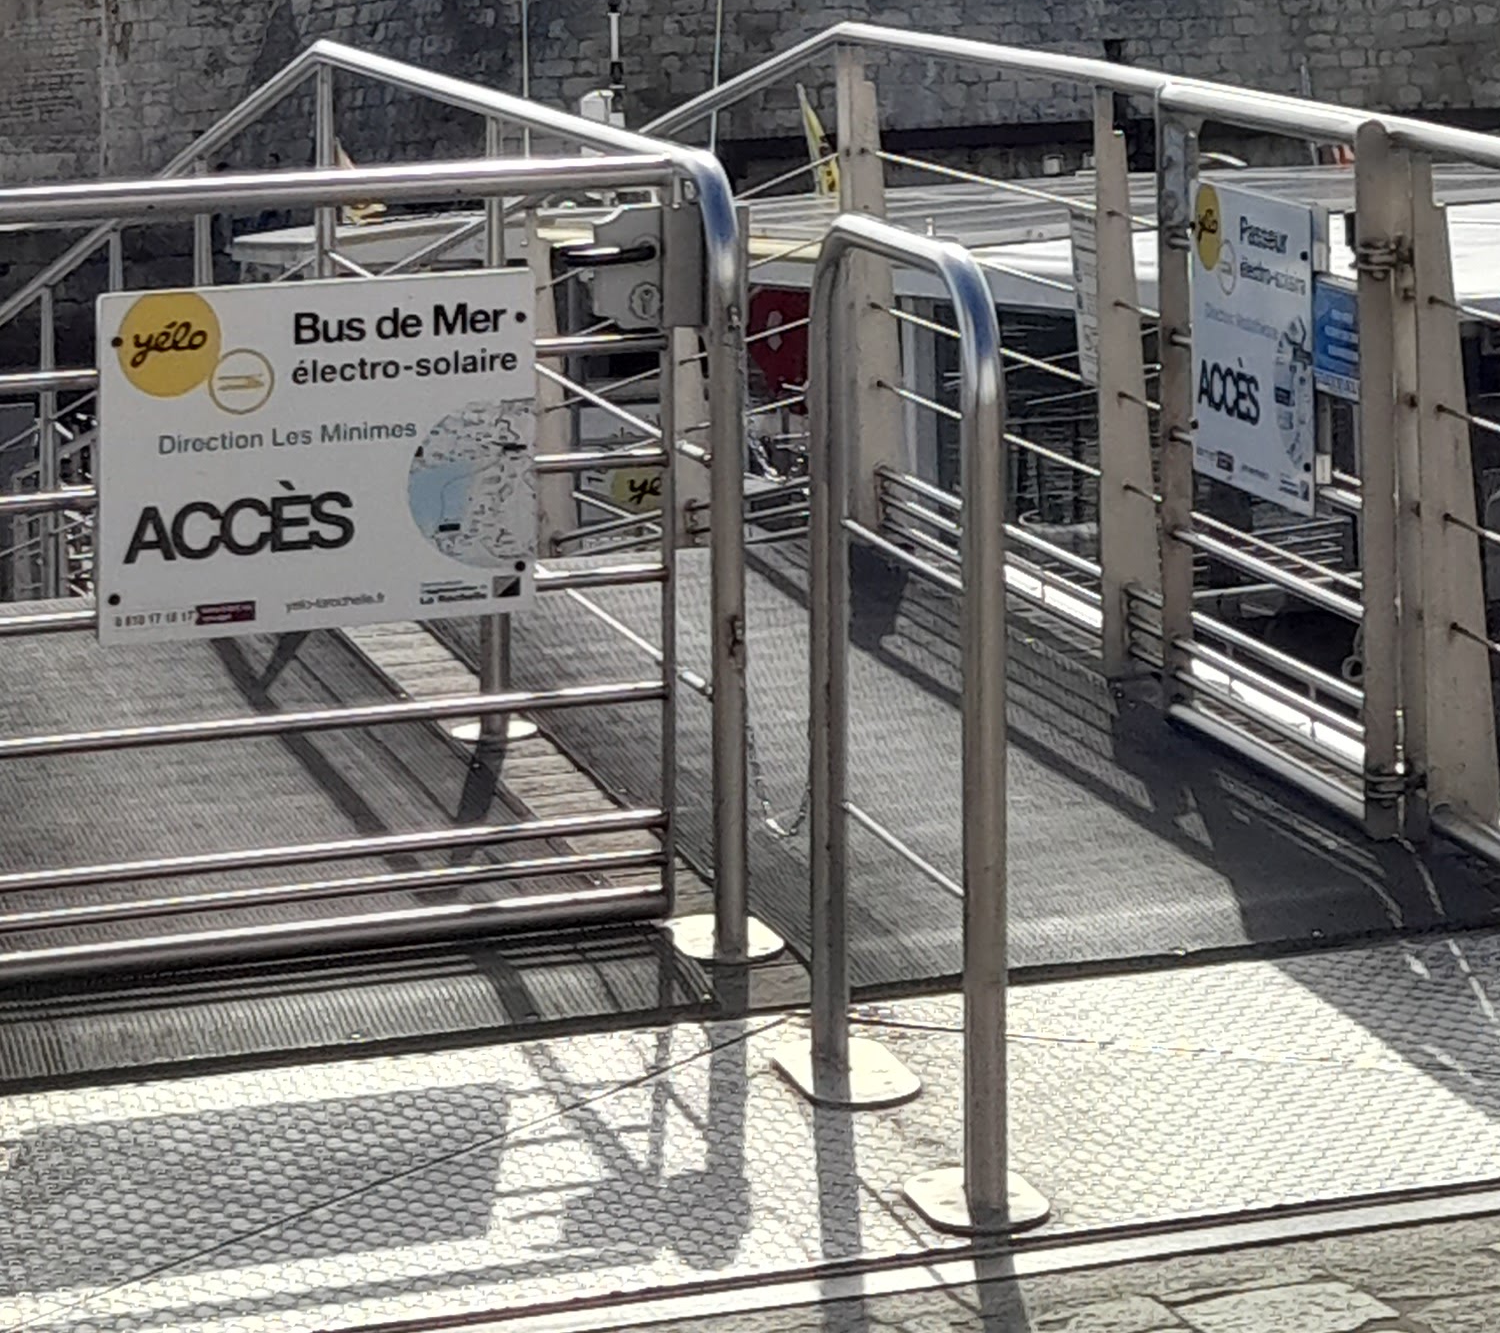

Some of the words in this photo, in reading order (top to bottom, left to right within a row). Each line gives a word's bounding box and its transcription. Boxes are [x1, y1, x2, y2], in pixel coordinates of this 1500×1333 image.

[129, 320, 208, 369] yélo
[293, 312, 366, 346] Bus
[375, 307, 423, 340] de
[432, 302, 507, 336] Mer
[291, 347, 518, 385] électro-solaire
[1197, 356, 1261, 427] ACCÈS
[158, 431, 263, 455] Direction
[272, 428, 312, 447] Les
[320, 421, 417, 443] Minimes
[122, 479, 356, 565] ACCÈS
